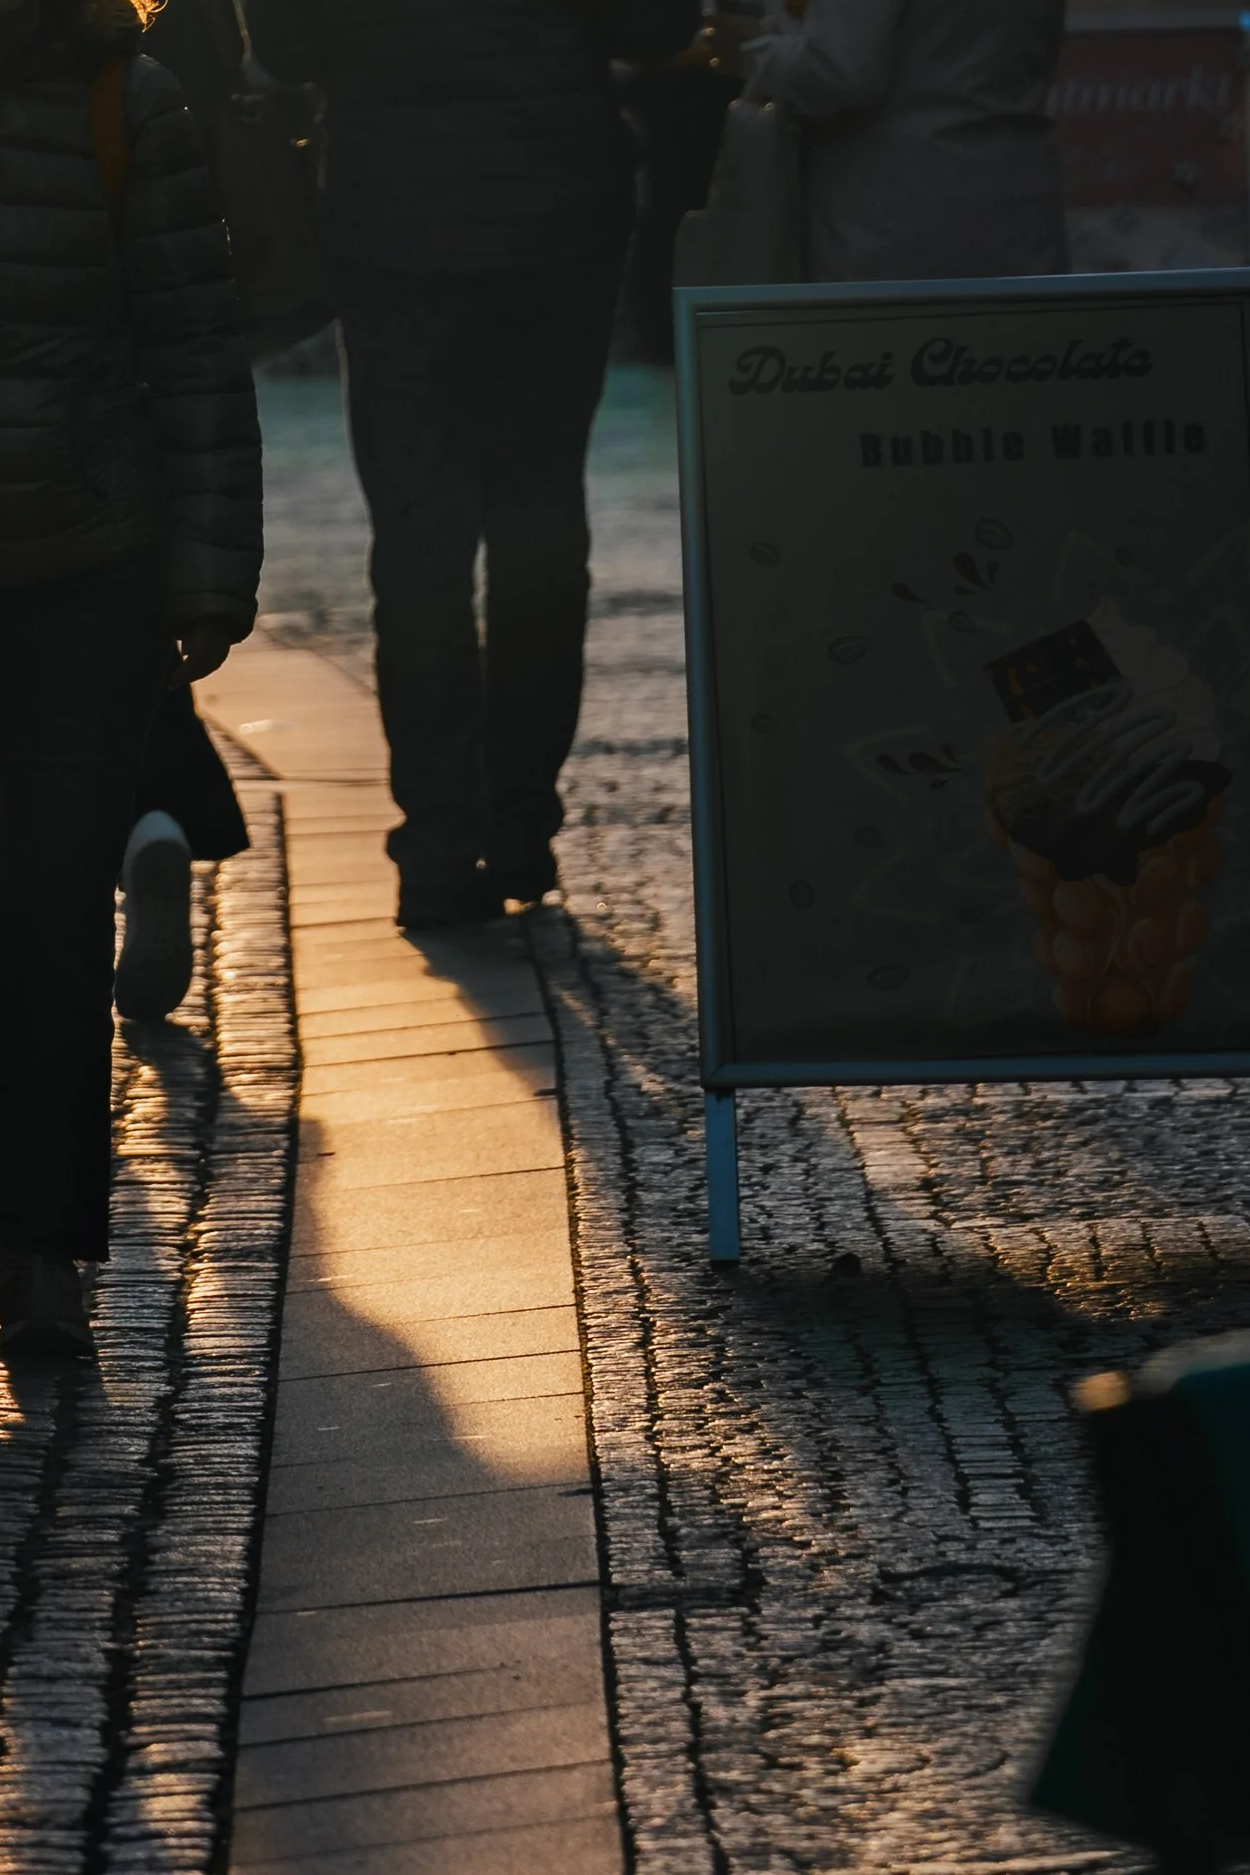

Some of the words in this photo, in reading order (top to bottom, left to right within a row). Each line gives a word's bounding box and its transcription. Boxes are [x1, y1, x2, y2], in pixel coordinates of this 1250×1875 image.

[727, 345, 895, 397] Dubai
[909, 336, 1154, 388] Chocolate
[859, 426, 1026, 469] Bubble
[1051, 417, 1207, 460] Waffle
